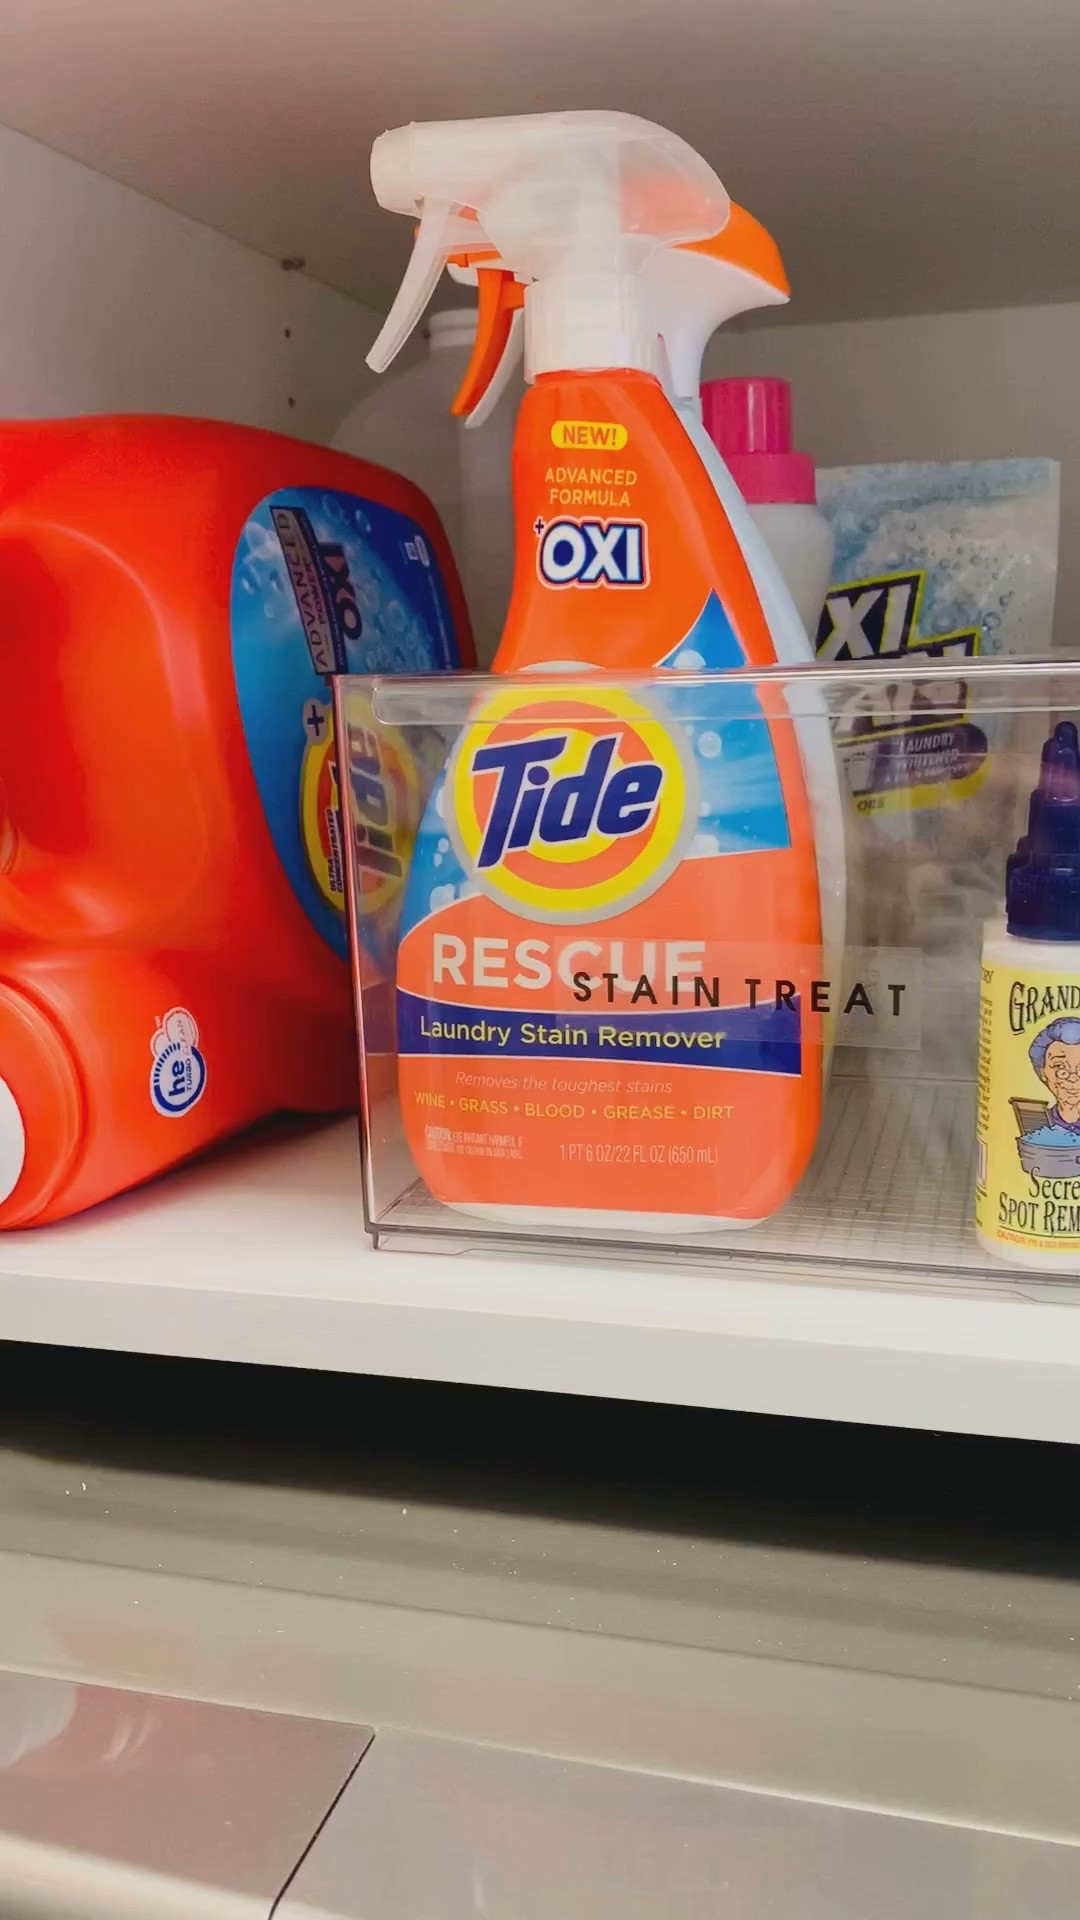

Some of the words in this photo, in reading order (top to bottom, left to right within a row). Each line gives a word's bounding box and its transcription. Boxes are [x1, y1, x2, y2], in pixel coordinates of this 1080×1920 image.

[562, 425, 617, 446] NEW!
[545, 467, 637, 486] ADVANCED
[549, 488, 631, 507] FORMULA
[276, 513, 329, 668] ADVANCED
[471, 735, 664, 869] Tide
[432, 932, 707, 994] RESCUE
[573, 971, 720, 1007] STAIN
[744, 978, 906, 1017] TREAT
[420, 1015, 511, 1047] Laundry
[520, 1022, 589, 1046] Stain
[599, 1026, 726, 1050] Remover
[168, 1060, 185, 1097] he
[455, 1071, 518, 1090] Removes
[523, 1077, 547, 1091] the
[552, 1078, 624, 1095] toughest
[626, 1079, 673, 1094] stains
[414, 1090, 446, 1108] WINE
[459, 1097, 508, 1115] GRASS
[524, 1103, 585, 1119] BLOOD
[603, 1105, 675, 1120] GREASE
[693, 1106, 734, 1120] DIRT
[569, 1144, 583, 1161] PT
[586, 1144, 593, 1162] 6
[633, 1145, 647, 1164] FL
[650, 1145, 665, 1164] OZ
[668, 1145, 694, 1167] (650
[998, 1191, 1039, 1229] SPOT
